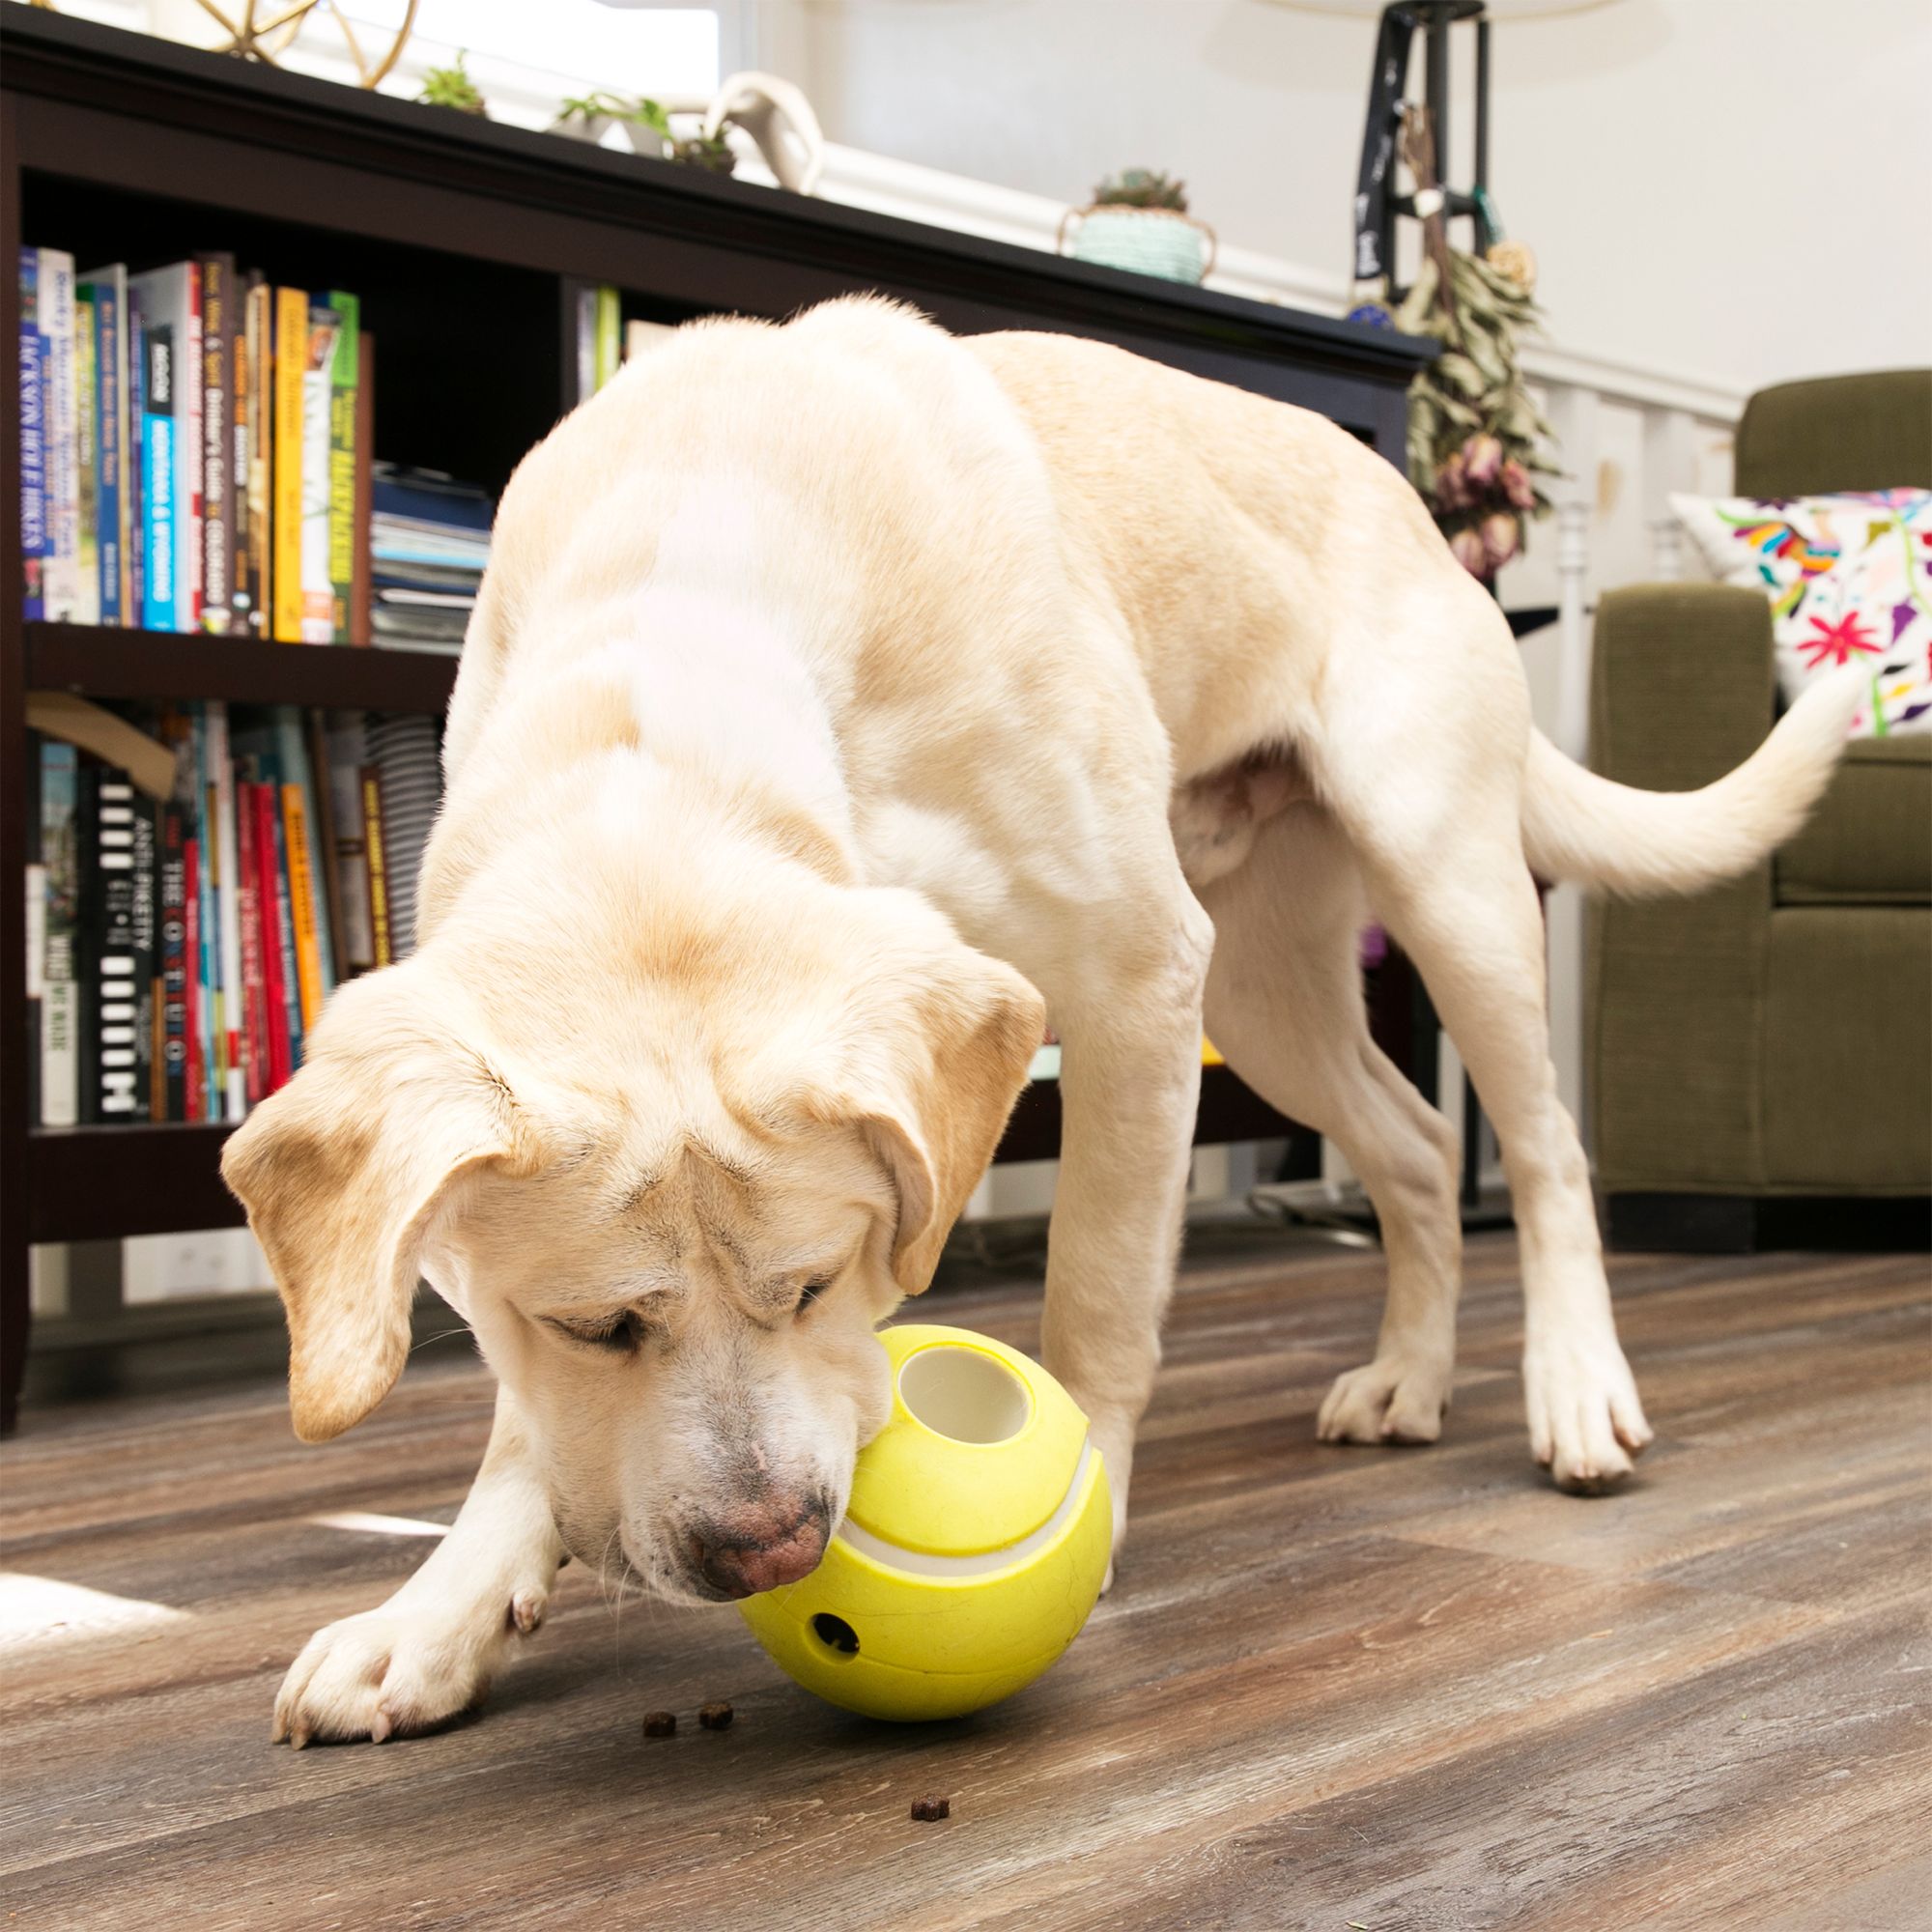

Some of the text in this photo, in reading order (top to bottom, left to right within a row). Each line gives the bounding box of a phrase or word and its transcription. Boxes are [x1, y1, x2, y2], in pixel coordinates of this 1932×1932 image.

[205, 338, 224, 351] &
[19, 335, 44, 550] JACKSON HOLE HIKES
[54, 270, 74, 558] Rocky Mountain National Park
[151, 343, 172, 604] MOON MONTANA & WYOMING
[204, 387, 225, 457] Drinker's
[205, 457, 224, 502] Guide
[205, 519, 225, 605] COLORADO
[328, 449, 356, 583] BACKPACKING
[131, 817, 155, 952] ANTI-PIKETTY
[161, 860, 187, 1079] THE CONSTITUTION
